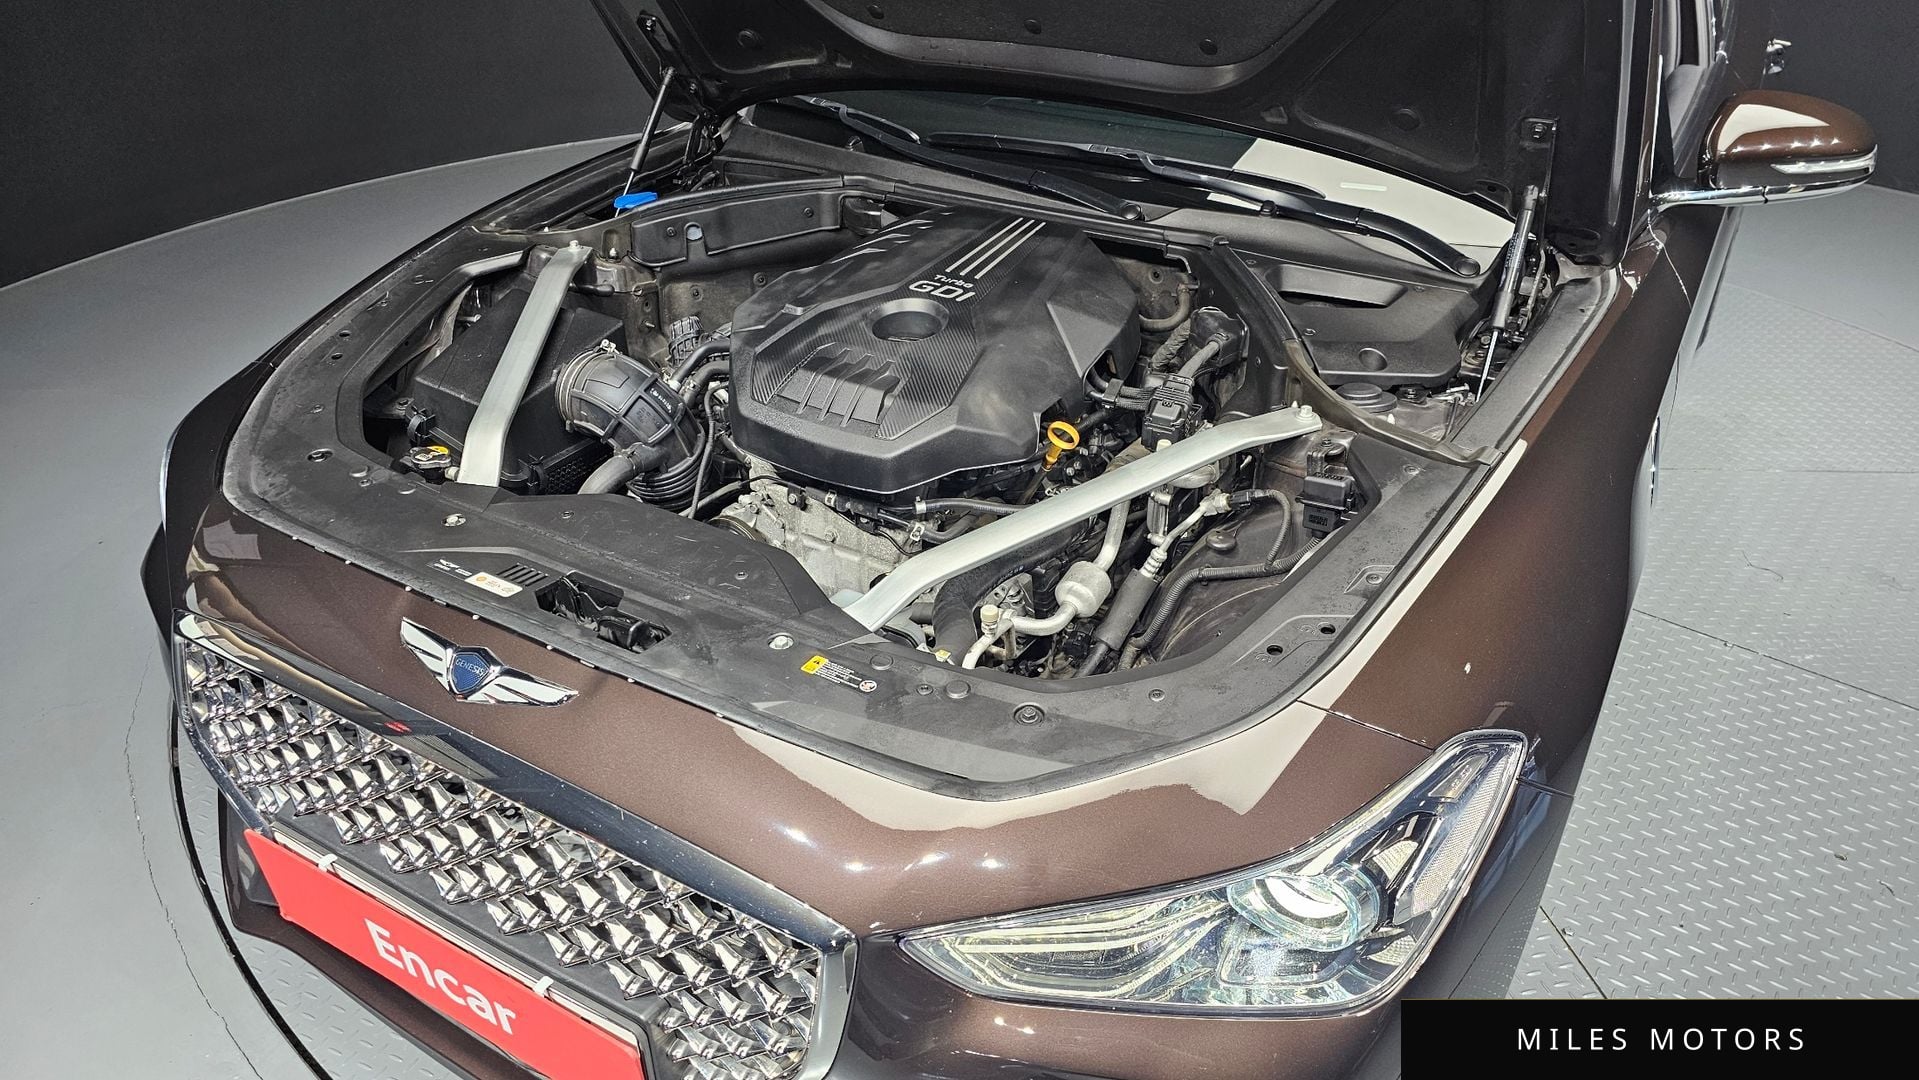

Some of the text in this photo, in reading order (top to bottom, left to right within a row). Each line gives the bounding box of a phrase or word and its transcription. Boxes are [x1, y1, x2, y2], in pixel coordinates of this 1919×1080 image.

[908, 280, 976, 302] GDI
[934, 274, 974, 289] Turbo
[455, 658, 485, 677] GENESIS
[364, 918, 516, 1036] Encar
